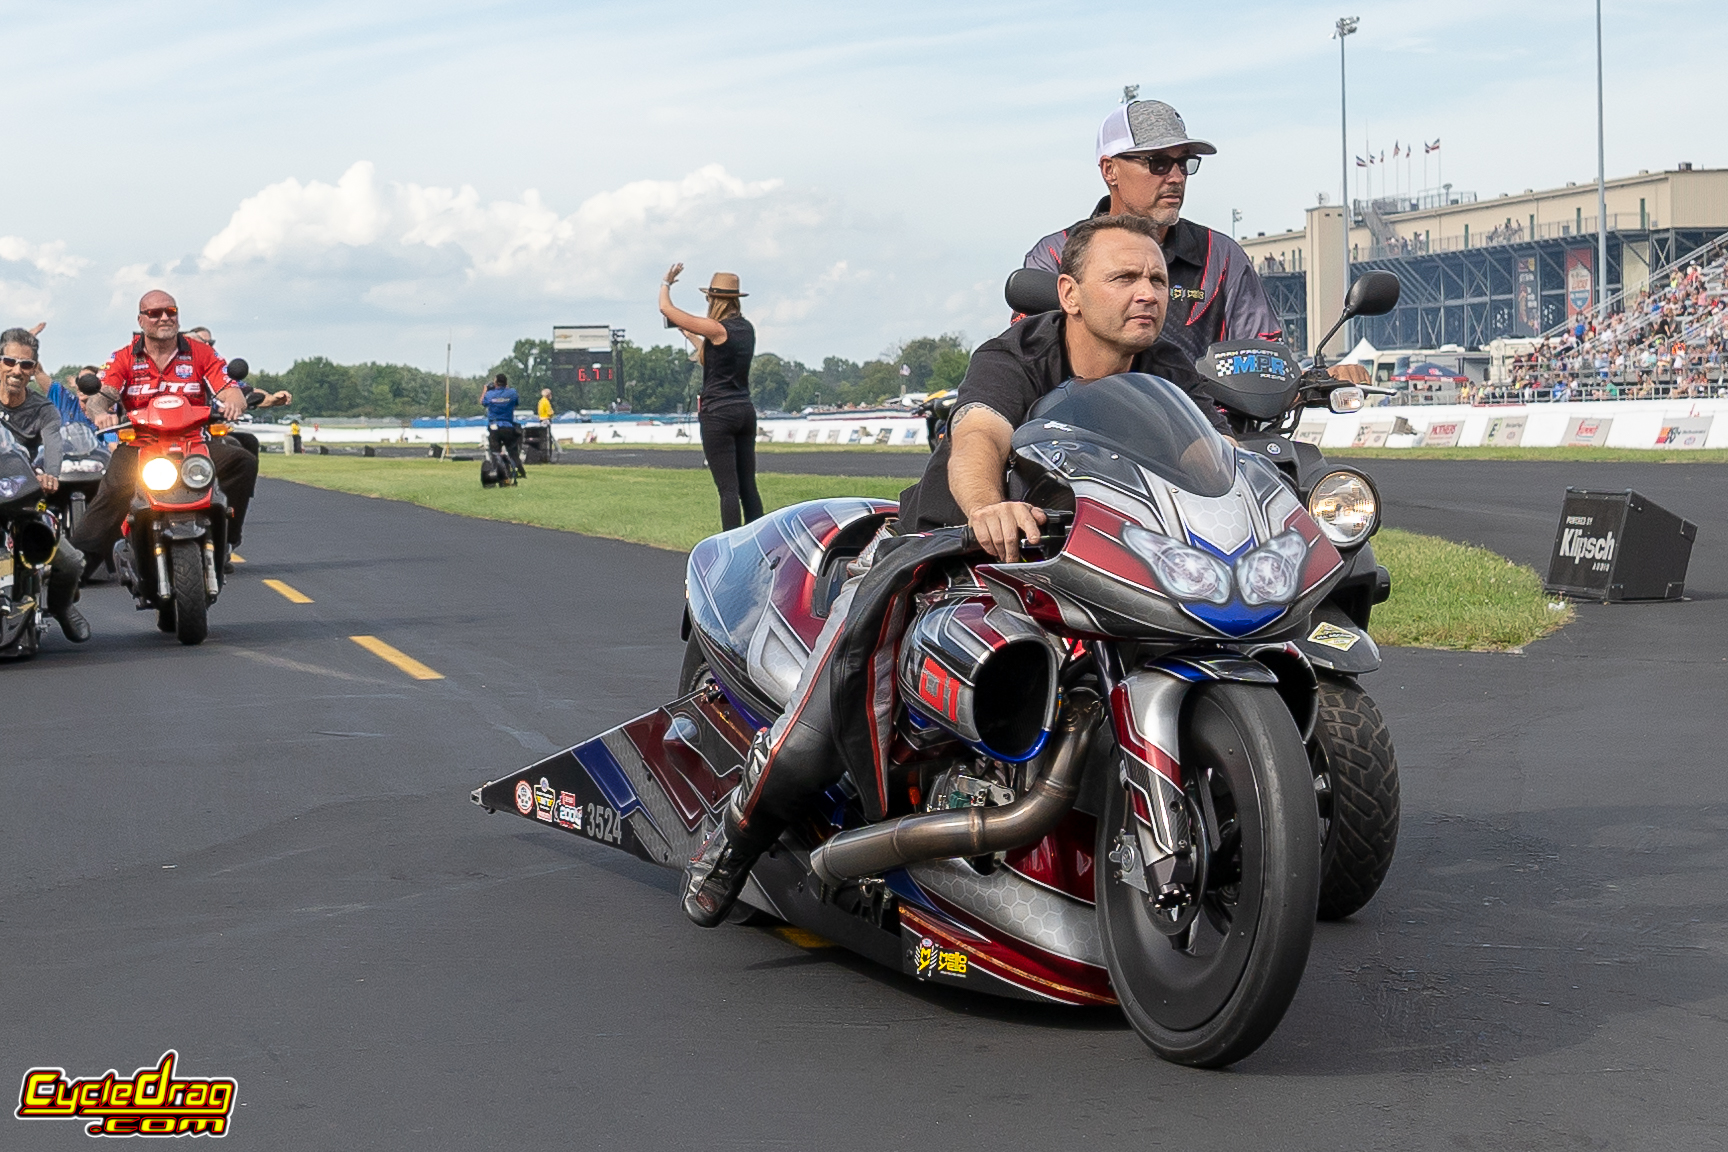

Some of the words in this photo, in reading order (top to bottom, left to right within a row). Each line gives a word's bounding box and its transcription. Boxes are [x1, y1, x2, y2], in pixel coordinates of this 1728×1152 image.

[1233, 355, 1286, 376] MPR
[127, 382, 201, 396] ELITE
[1559, 528, 1615, 564] Klipsch
[586, 803, 622, 845] 3524
